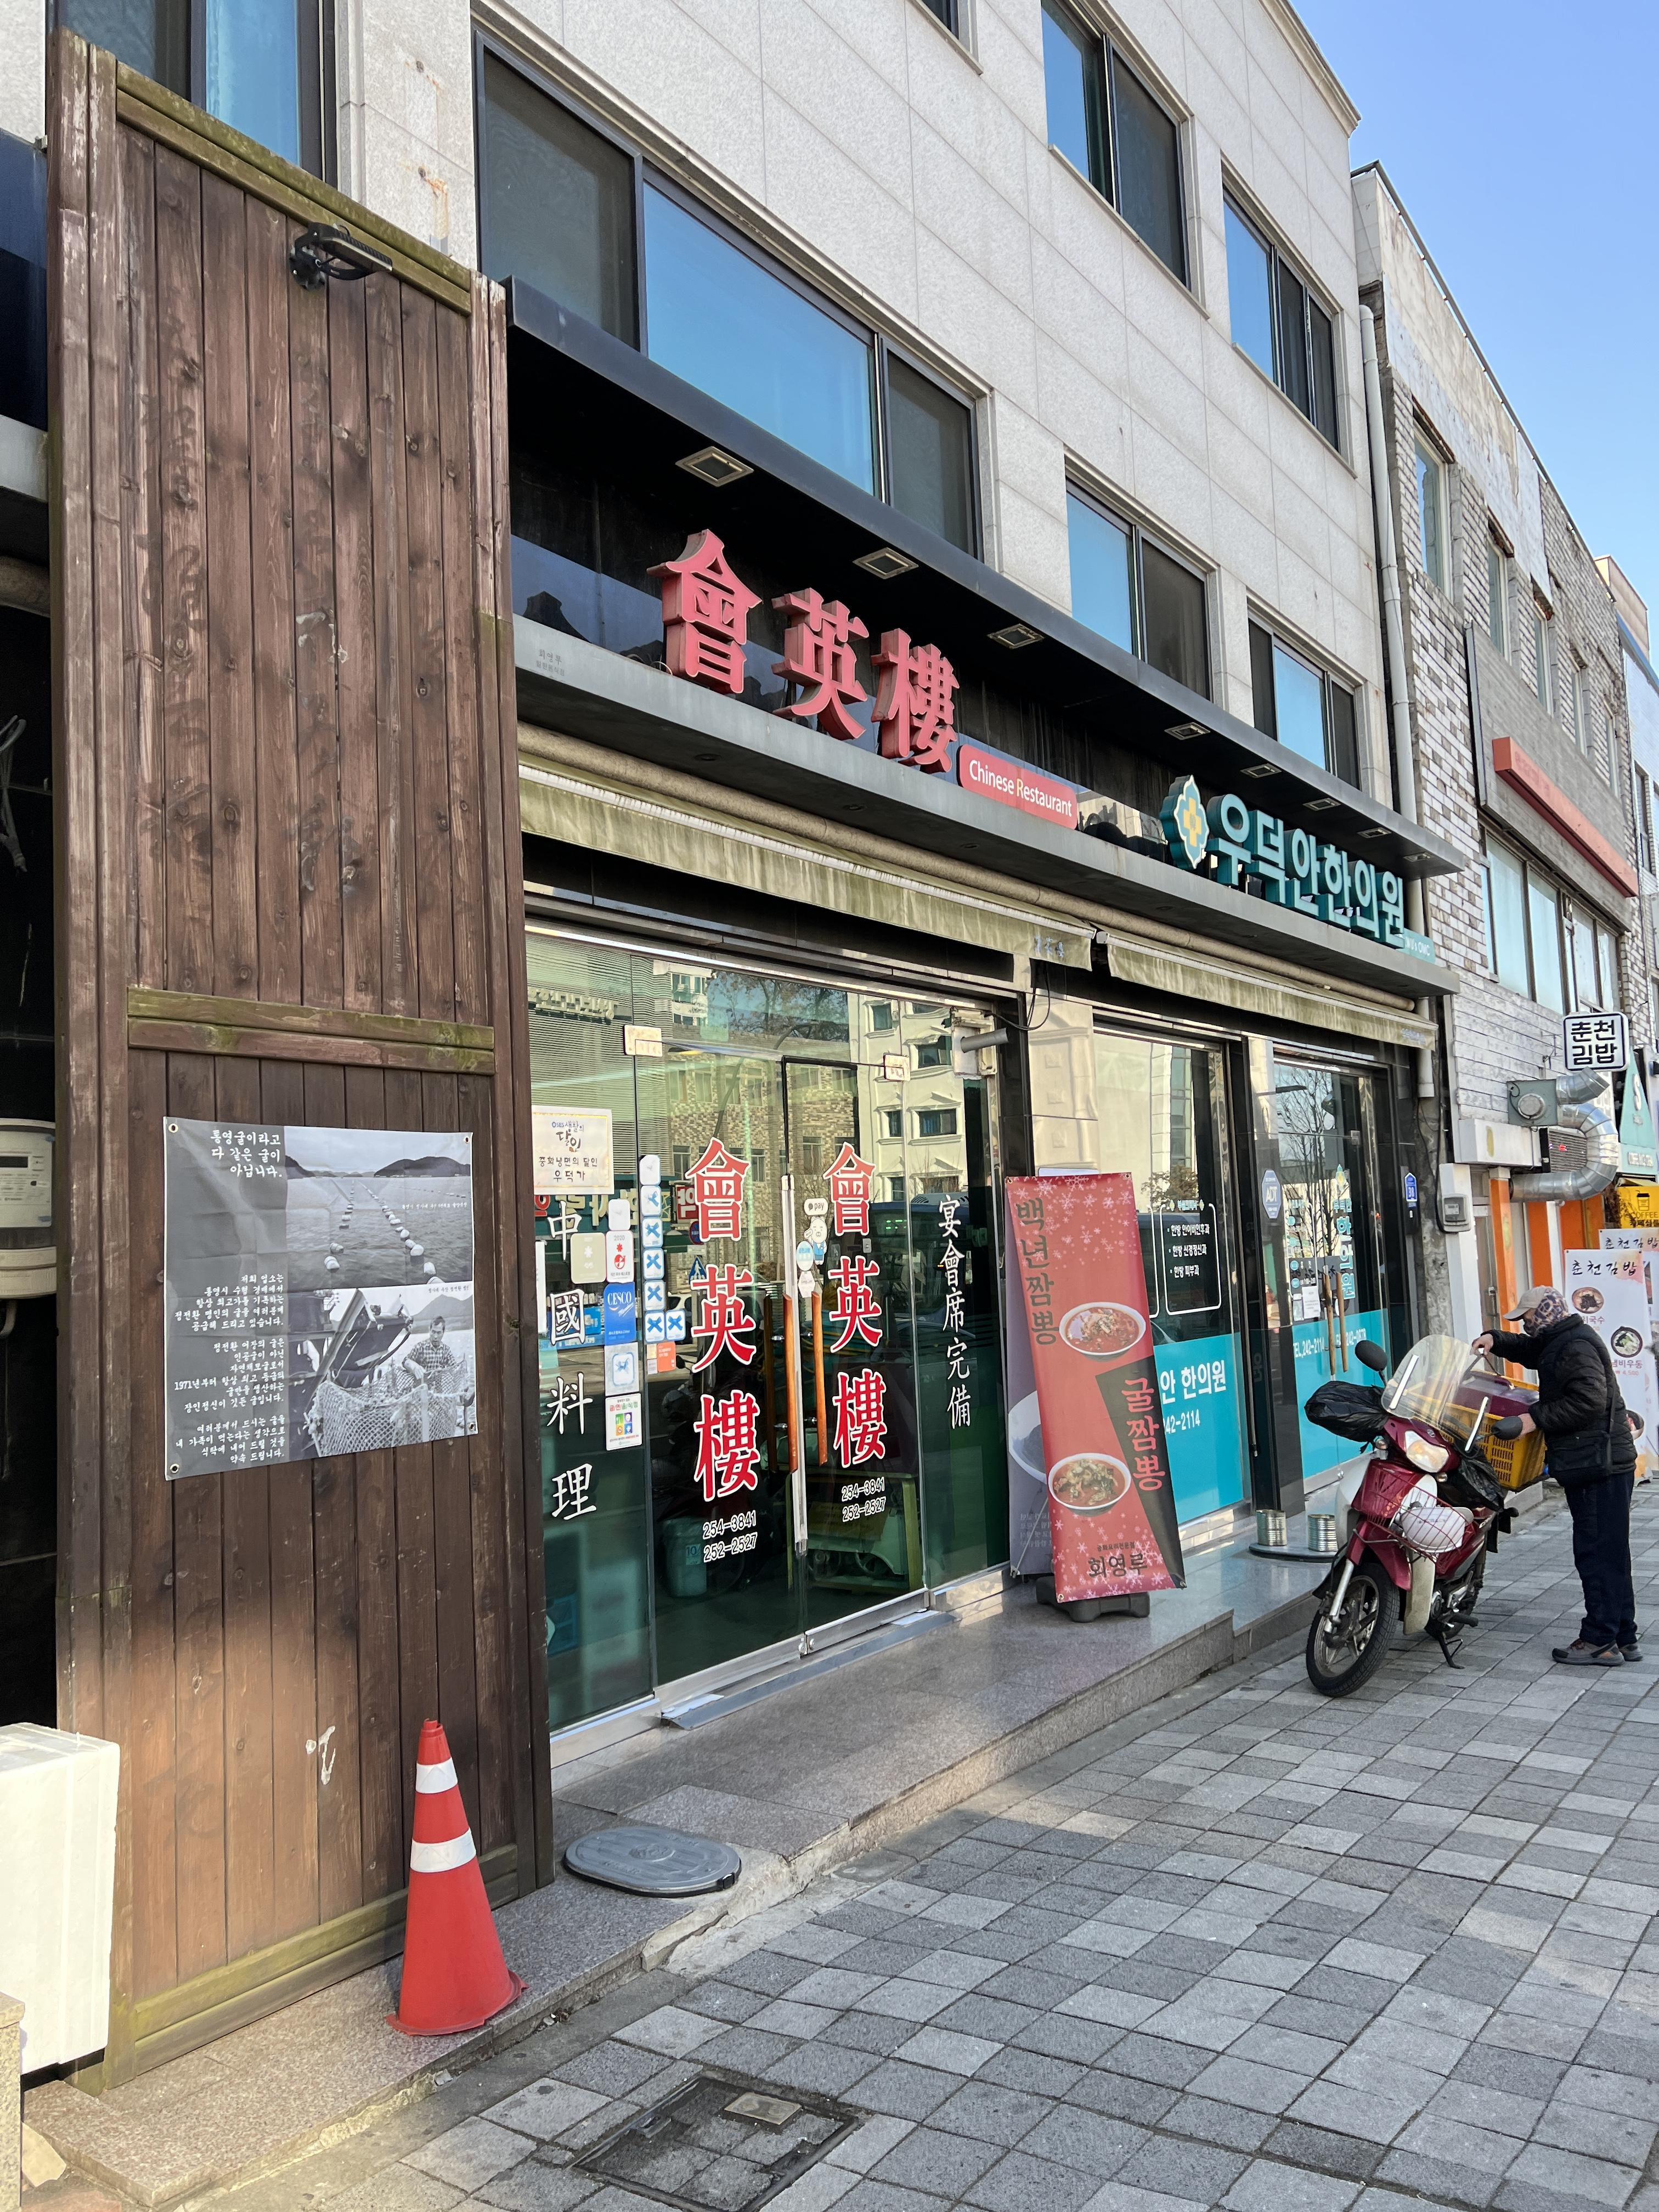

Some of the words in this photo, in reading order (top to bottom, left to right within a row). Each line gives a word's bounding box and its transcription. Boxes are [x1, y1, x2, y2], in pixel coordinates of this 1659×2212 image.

[647, 529, 960, 773] 會英樓
[969, 760, 1014, 794] Chinese
[1017, 778, 1072, 817] Restaurant
[1207, 794, 1405, 949] 우덕안한의원
[1571, 1020, 1616, 1042] 춘천
[1572, 1043, 1617, 1065] 김밥
[211, 1130, 280, 1146] 통영굴이라고
[211, 1146, 224, 1160] 다
[230, 1148, 252, 1161] 같은
[258, 1149, 280, 1163] 굴이
[539, 1156, 579, 1167] 중화냉면의
[583, 1157, 597, 1167] 달인
[230, 1163, 282, 1177] 아닙니다.
[1266, 1186, 1278, 1203] ADT
[815, 1203, 824, 1211] pay
[1171, 1224, 1181, 1237] 한방
[1182, 1223, 1210, 1236] 안이비인후과
[1172, 1245, 1182, 1257] 한방
[1184, 1244, 1207, 1256] 신경정신과
[241, 1274, 257, 1283] 저희
[261, 1274, 284, 1284] 업소는
[1016, 1198, 1060, 1346] 백년짬뽕
[1174, 1266, 1184, 1278] 한방
[1185, 1265, 1199, 1277] 피부과
[204, 1286, 228, 1297] 통영시
[253, 1284, 283, 1295] 경매에서
[607, 1291, 632, 1305] CESCO
[196, 1297, 213, 1308] 항상
[217, 1296, 249, 1306] 최고가를
[253, 1295, 284, 1305] 기록하는
[823, 1142, 887, 1468] 會英樓
[205, 1308, 228, 1319] 명인의
[233, 1307, 249, 1318] 굴을
[685, 1137, 760, 1502] 會英樓
[938, 1195, 972, 1429] 宴會席完備
[1582, 1316, 1606, 1324] 치국수
[192, 1320, 216, 1331] 공급해
[222, 1319, 245, 1329] 드리고
[249, 1317, 283, 1328] 있습니다.
[242, 1339, 264, 1350] 어장의
[269, 1338, 285, 1348] 굴은
[234, 1351, 264, 1362] 인공굴이
[269, 1348, 284, 1359] 아닌
[547, 1200, 597, 1521] 中國料理
[222, 1375, 238, 1386] 항상
[241, 1374, 257, 1383] 최고
[262, 1371, 284, 1382] 등급의
[1181, 1359, 1226, 1400] 한의원
[226, 1385, 250, 1397] 굴만을
[253, 1382, 284, 1394] 생산하는
[184, 1400, 225, 1413] 장인정신이
[230, 1396, 246, 1408] 깃든
[250, 1393, 284, 1406] 굴입니다.
[242, 1417, 266, 1428] 드시는
[269, 1414, 285, 1426] 굴을
[1163, 1409, 1200, 1434] 42-2114
[189, 1435, 213, 1447] 가족이
[218, 1430, 250, 1443] 먹는다는
[255, 1426, 285, 1438] 생각으로
[1121, 1378, 1166, 1492] 굴짬뽕
[201, 1444, 225, 1457] 식탁에
[230, 1442, 245, 1452] 내어
[250, 1439, 265, 1449] 드릴
[270, 1436, 285, 1447] 것을
[230, 1453, 246, 1464] 약속
[250, 1448, 285, 1461] 드립니다.
[842, 1477, 884, 1502] 254-3841
[842, 1496, 886, 1522] 252-2527
[703, 1510, 757, 1539] 254-3841
[704, 1532, 758, 1562] 252-2527
[1088, 1553, 1148, 1578] 회영루
